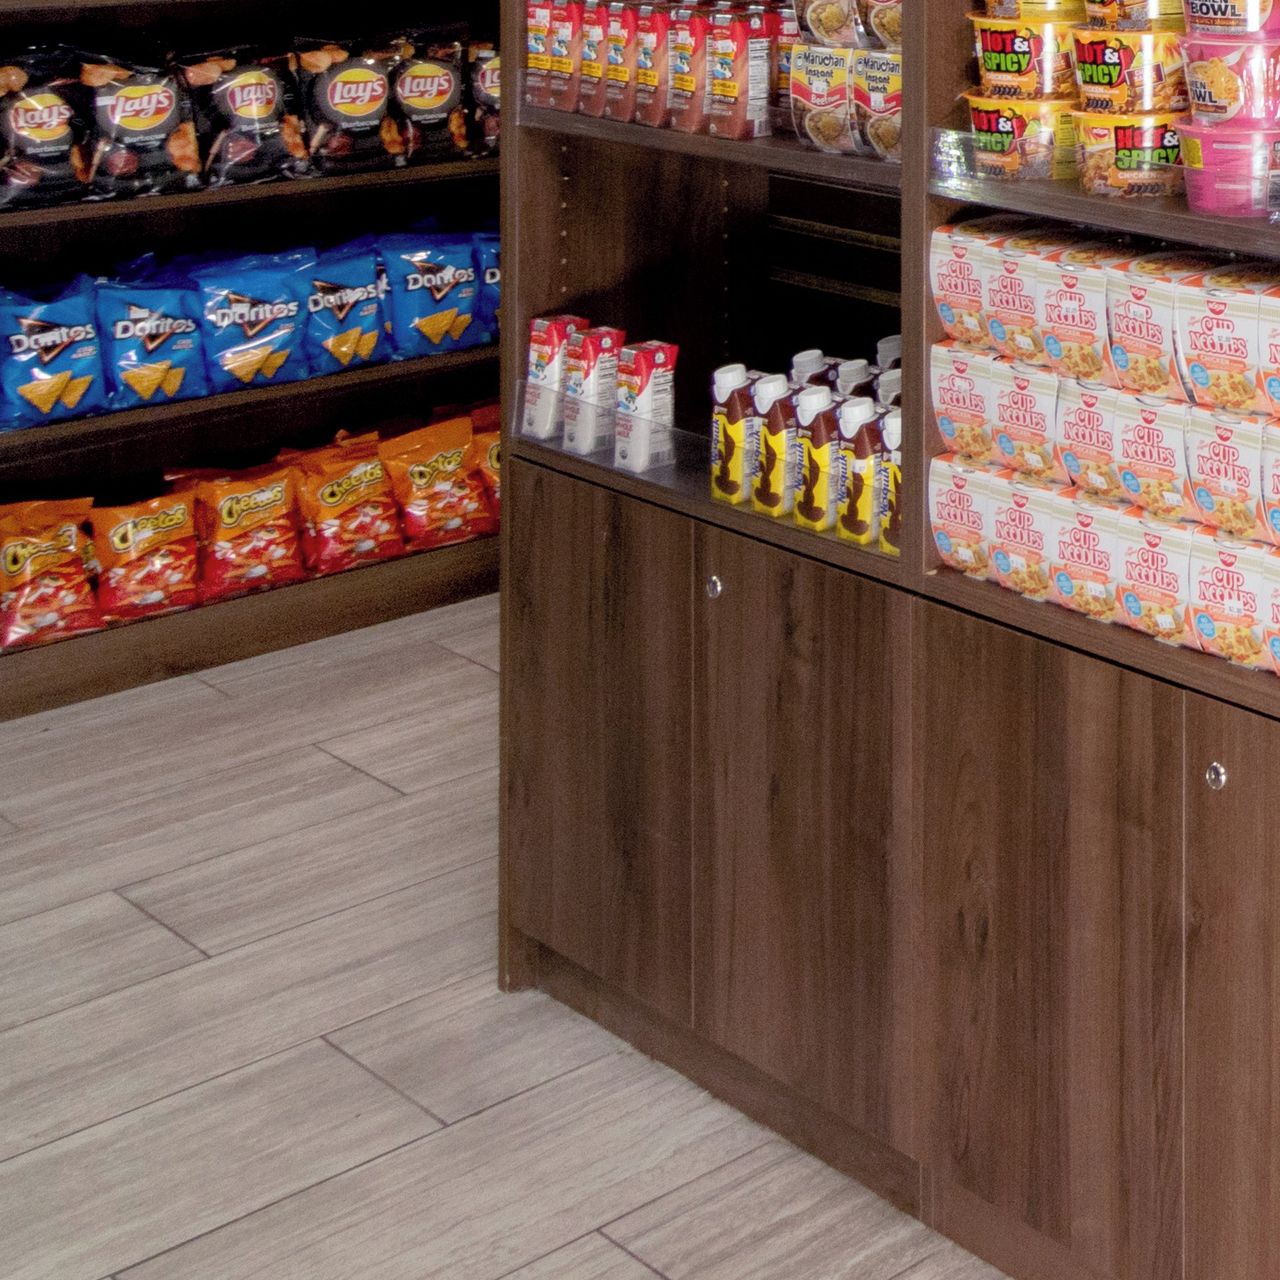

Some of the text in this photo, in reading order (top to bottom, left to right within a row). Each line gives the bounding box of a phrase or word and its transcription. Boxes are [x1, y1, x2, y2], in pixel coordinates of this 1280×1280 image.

[1191, 4, 1241, 17] BOWL
[984, 52, 1030, 72] SPICY
[1115, 149, 1181, 171] SPICY
[947, 260, 973, 277] CUP
[998, 275, 1024, 293] CUP
[308, 282, 379, 312] Doritos
[216, 298, 301, 328] Doritos
[114, 315, 198, 341] Doritos
[1134, 424, 1164, 447] CUP
[1121, 443, 1176, 469] NOODLES
